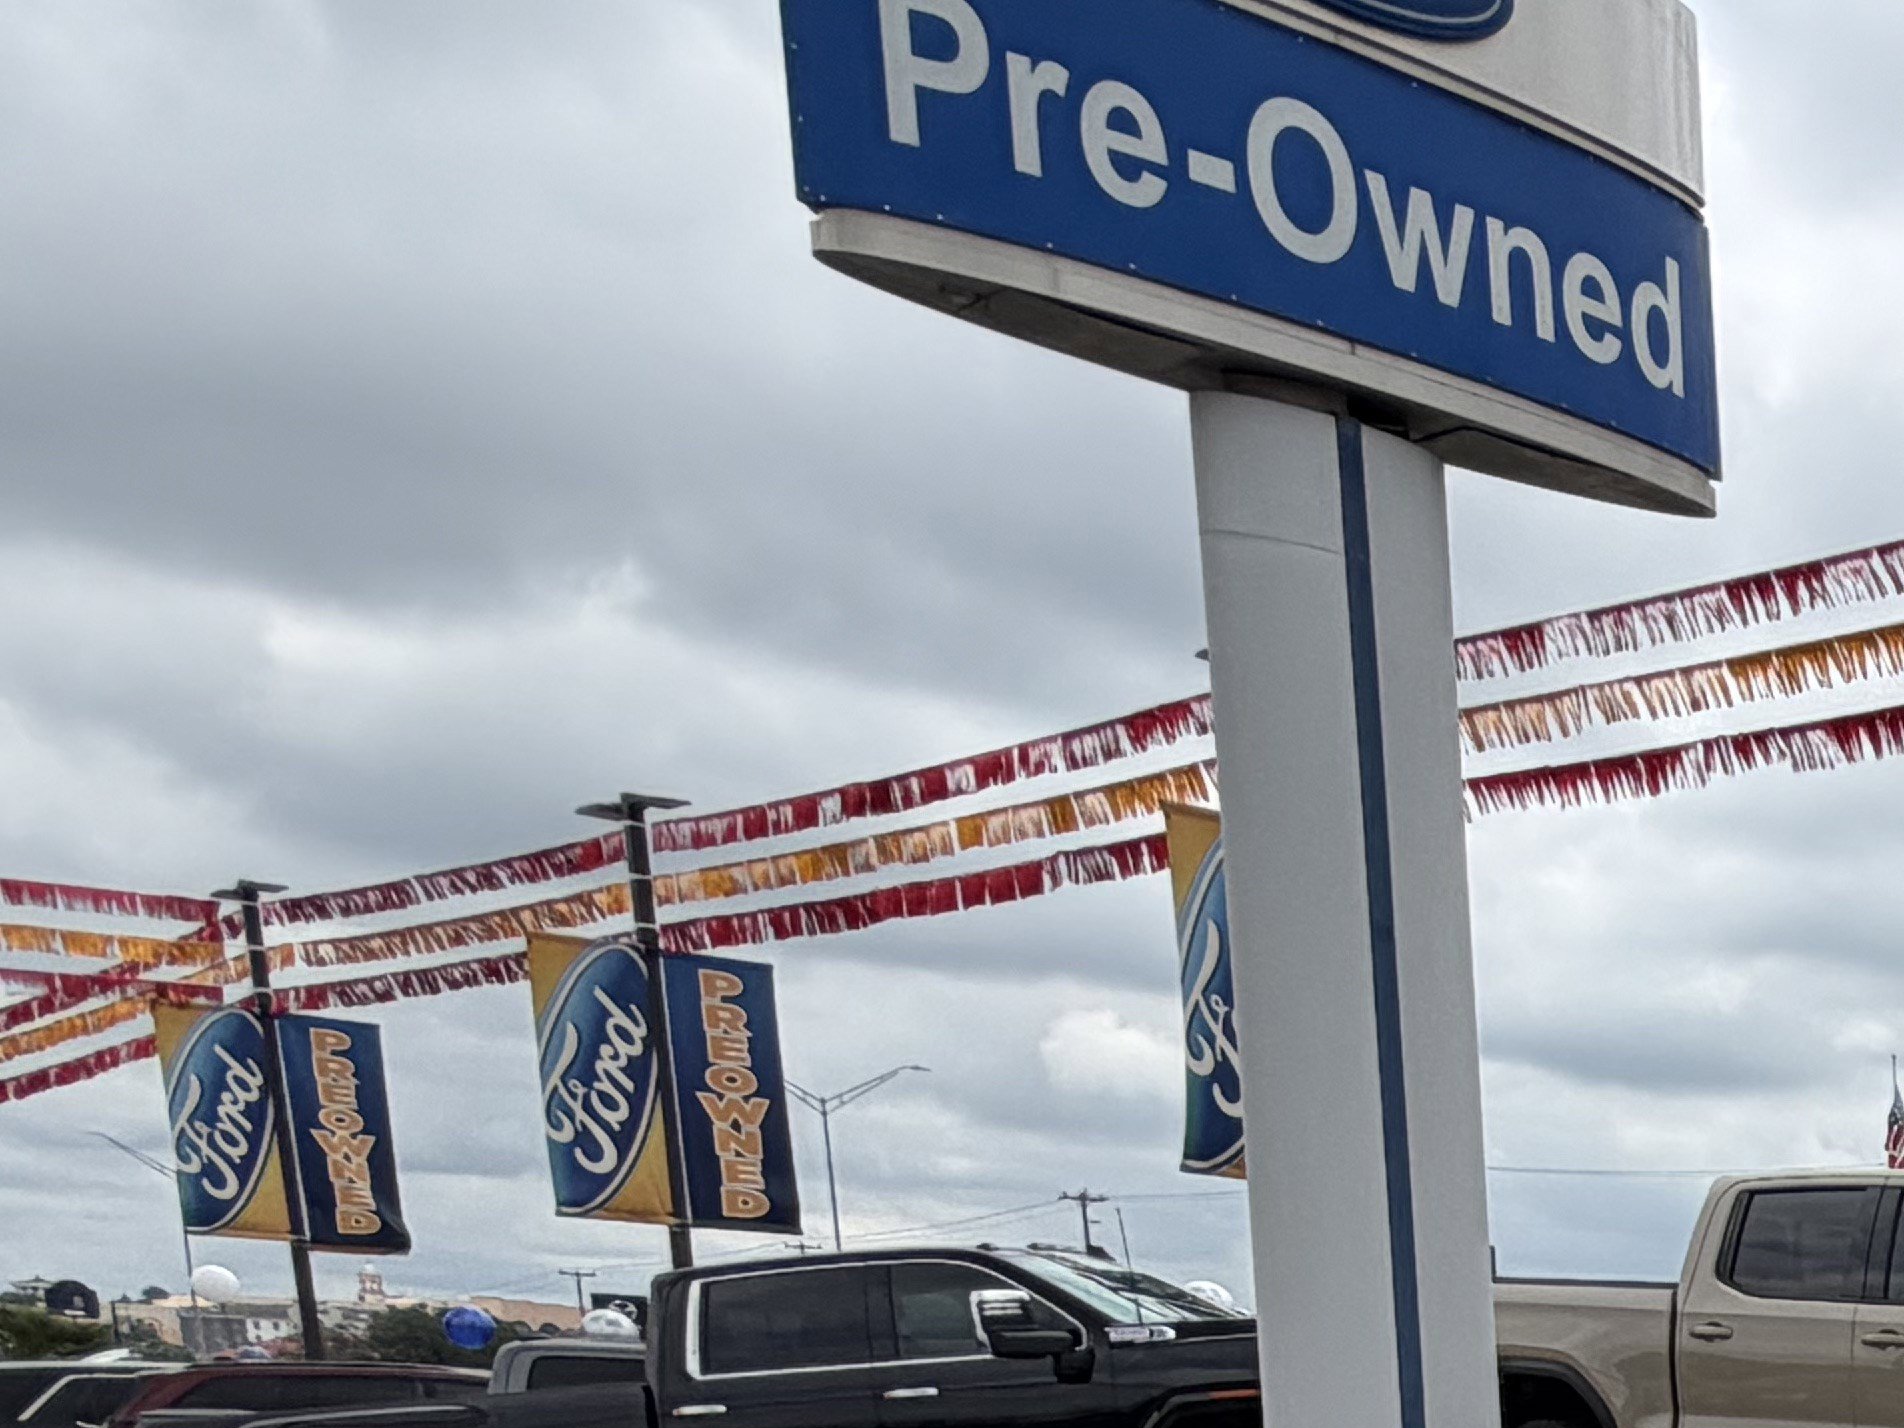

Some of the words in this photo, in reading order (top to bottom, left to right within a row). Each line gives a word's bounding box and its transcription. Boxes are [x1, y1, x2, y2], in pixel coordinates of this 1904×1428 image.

[877, 0, 1685, 397] Pre-Owned
[173, 1044, 265, 1201] Ford
[309, 1026, 382, 1236] PREOWNED
[544, 985, 650, 1175] Ford
[696, 968, 771, 1219] PREOWNED
